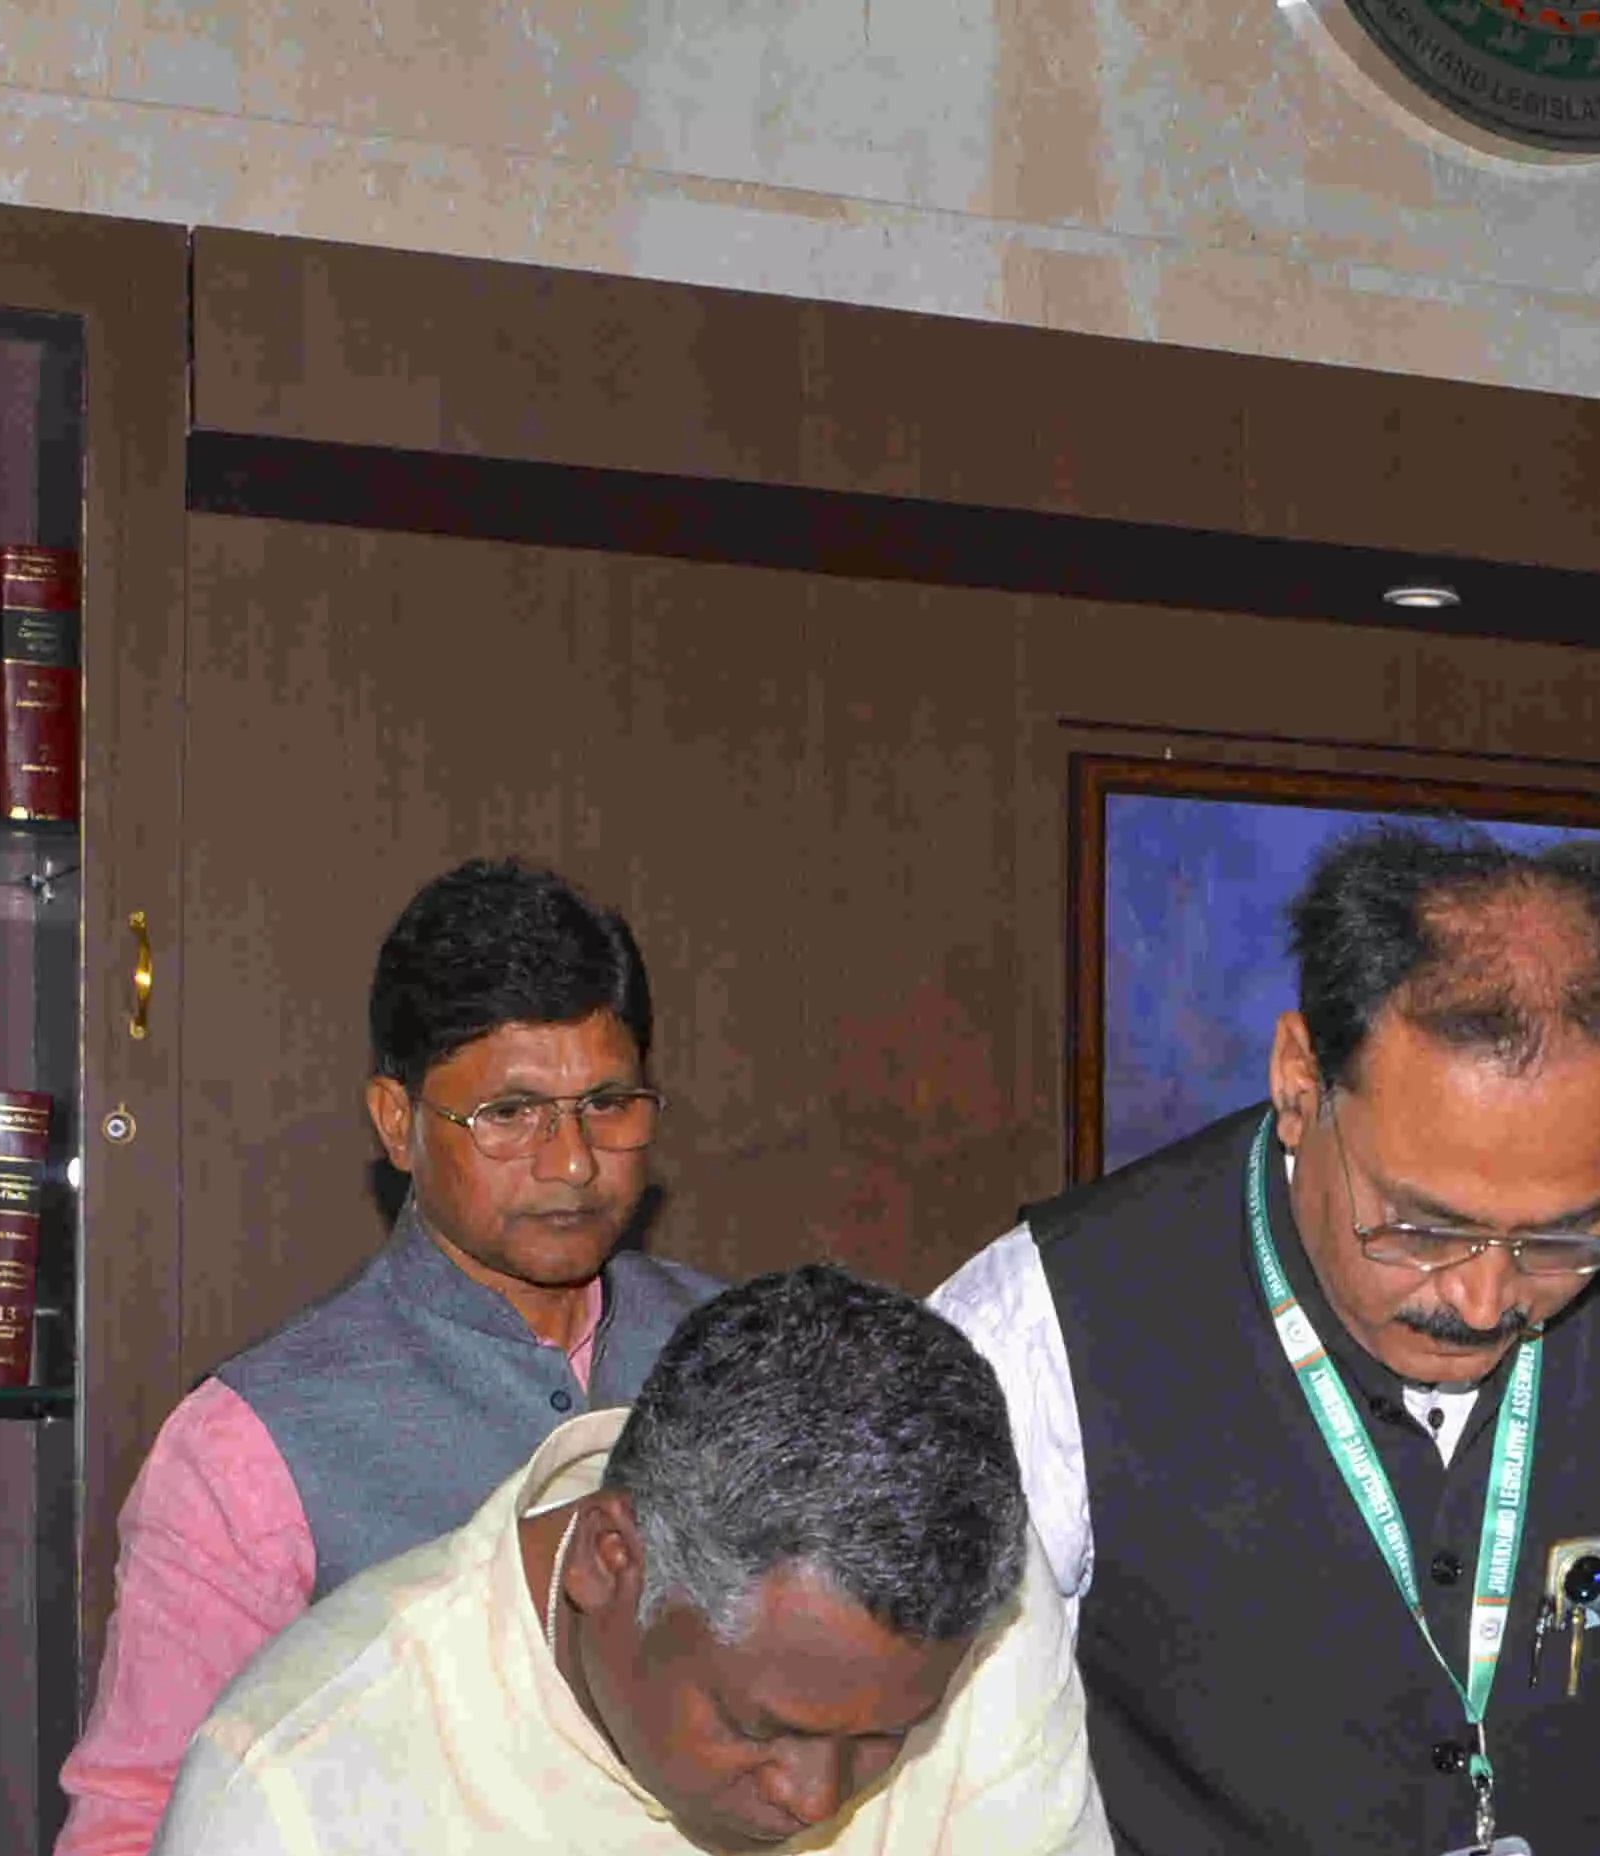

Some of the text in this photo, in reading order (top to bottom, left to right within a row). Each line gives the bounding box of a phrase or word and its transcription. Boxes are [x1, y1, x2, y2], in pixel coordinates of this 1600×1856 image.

[1487, 1343, 1536, 1595] JHARKHAND LEGISLATIVE ASSEMBLY
